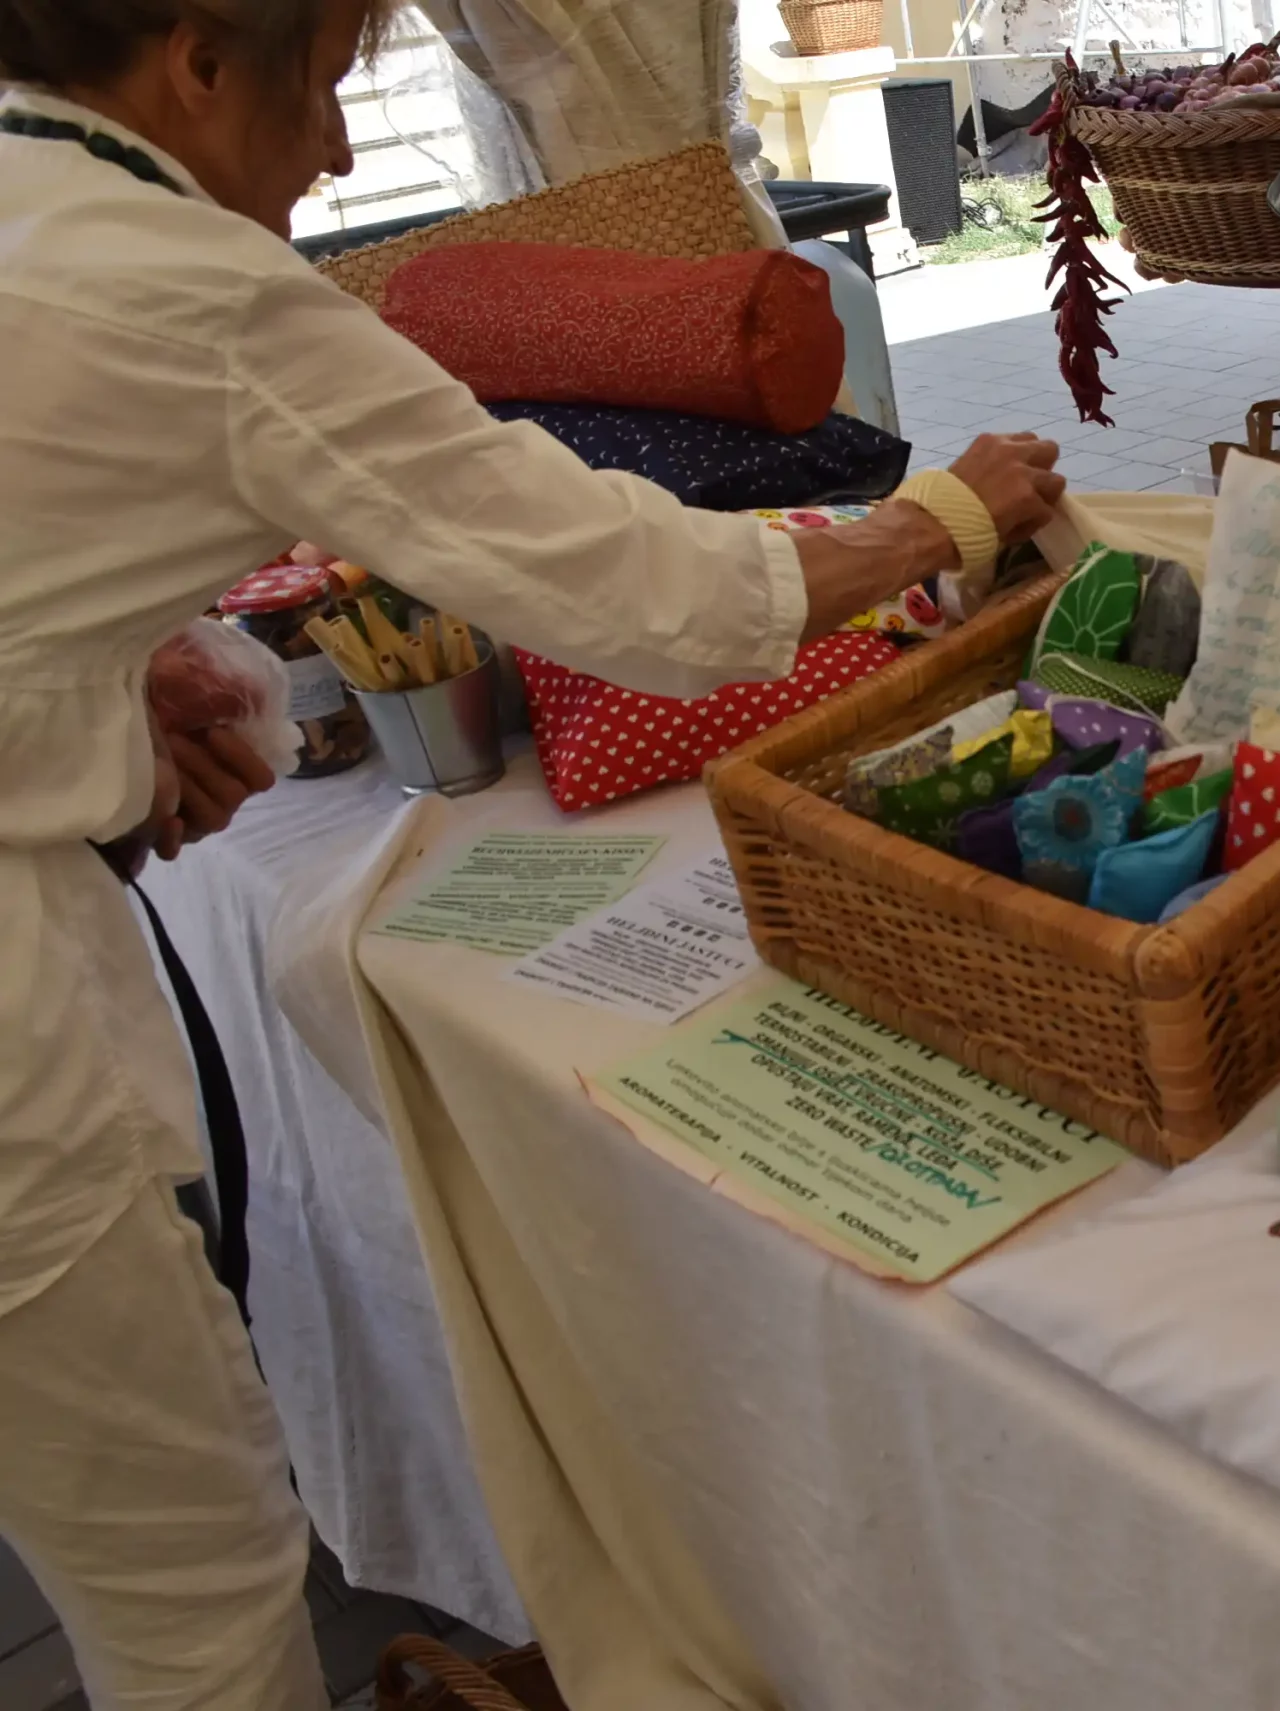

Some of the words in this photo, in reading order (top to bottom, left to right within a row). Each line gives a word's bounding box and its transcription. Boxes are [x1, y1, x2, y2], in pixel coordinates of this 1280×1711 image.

[812, 1023, 883, 1063] ORGANSKI
[887, 1064, 972, 1111] ANATOMSKI
[785, 1095, 827, 1121] ZERO
[823, 1115, 877, 1151] WASTE
[618, 1076, 722, 1144] AROMATERAPIJA
[739, 1150, 822, 1202] VITALNOST
[836, 1210, 920, 1264] KONDICIJA
